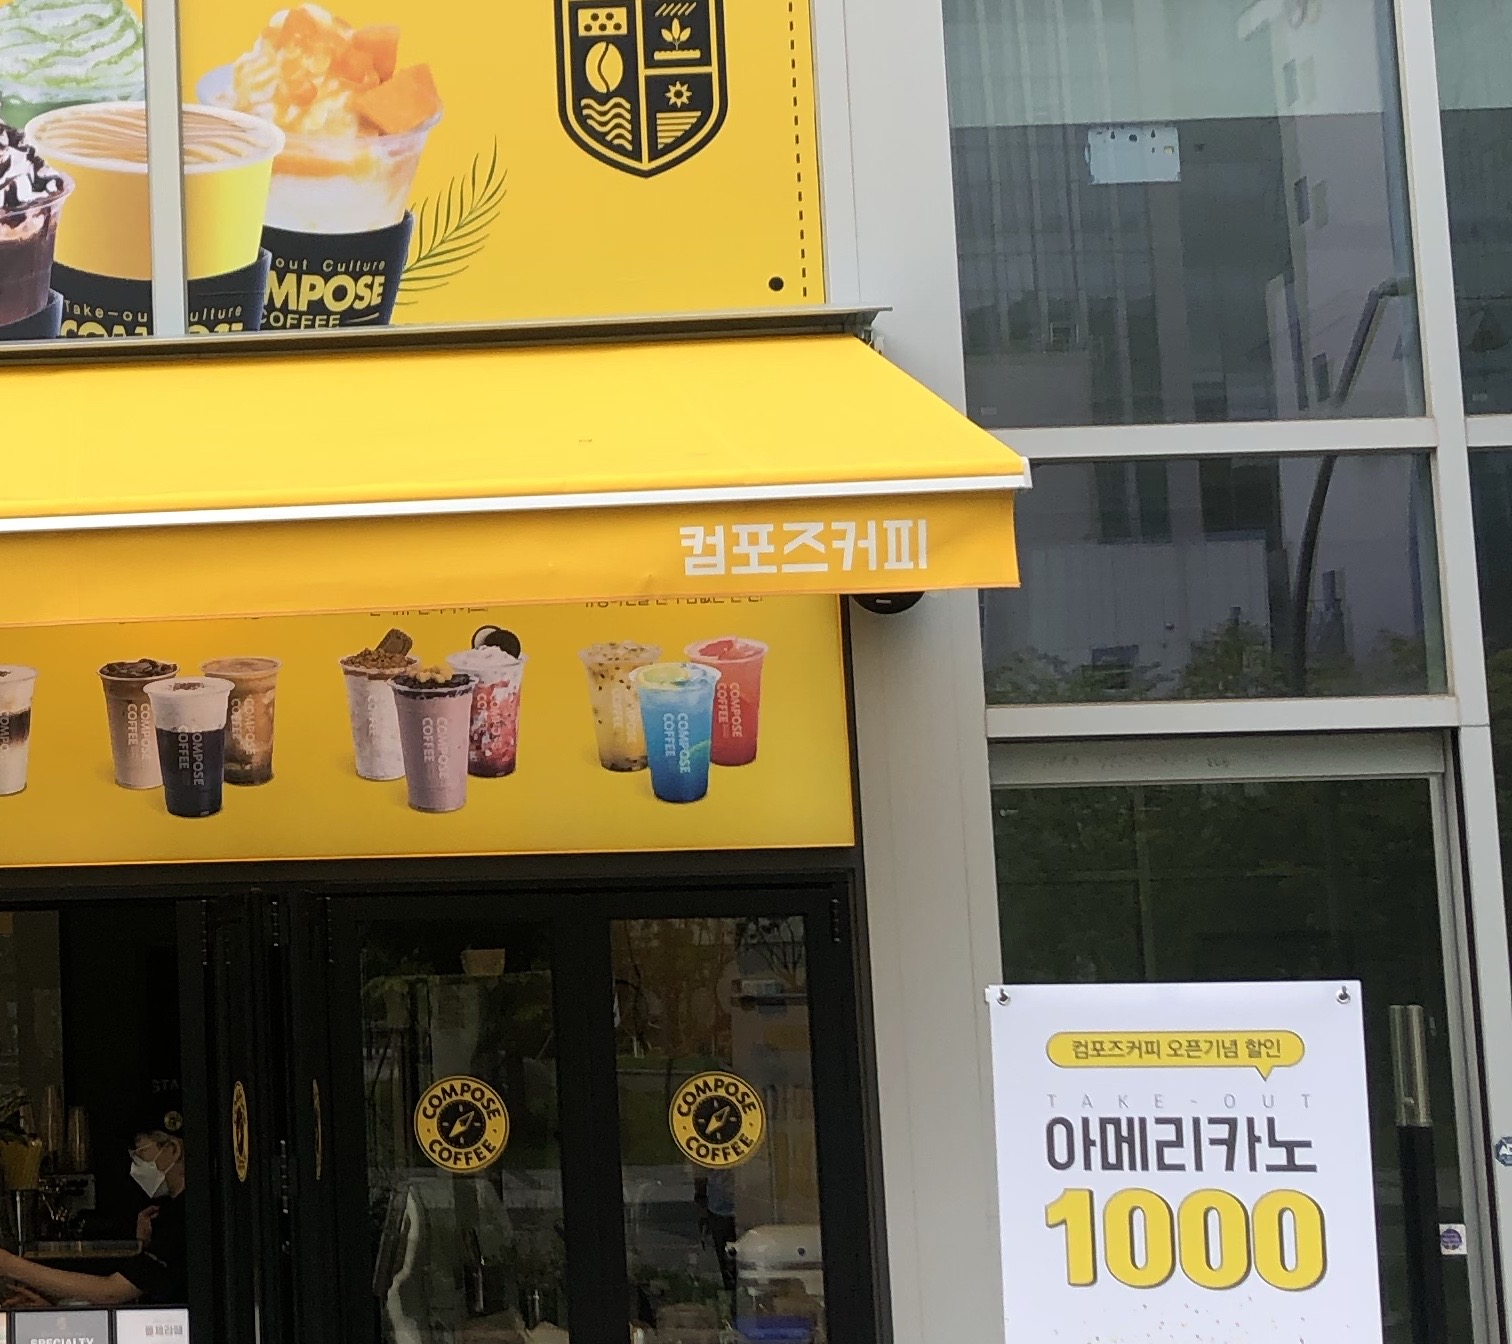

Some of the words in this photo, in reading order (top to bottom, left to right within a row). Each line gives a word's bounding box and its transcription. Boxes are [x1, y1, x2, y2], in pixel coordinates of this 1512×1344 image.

[679, 519, 927, 576] 컴포즈커피
[663, 712, 676, 757] COFFEE
[1071, 1038, 1162, 1059] 컴포즈커피
[1166, 1038, 1238, 1059] 오픈기념
[1244, 1037, 1281, 1059] 할인
[422, 1082, 501, 1121] COMPOSE
[677, 1077, 758, 1118] COMPOSE
[428, 1138, 497, 1167] COFFEE
[685, 1133, 755, 1162] COFFEE
[1045, 1116, 1318, 1172] 아메리카노
[1043, 1187, 1327, 1291] 1000
